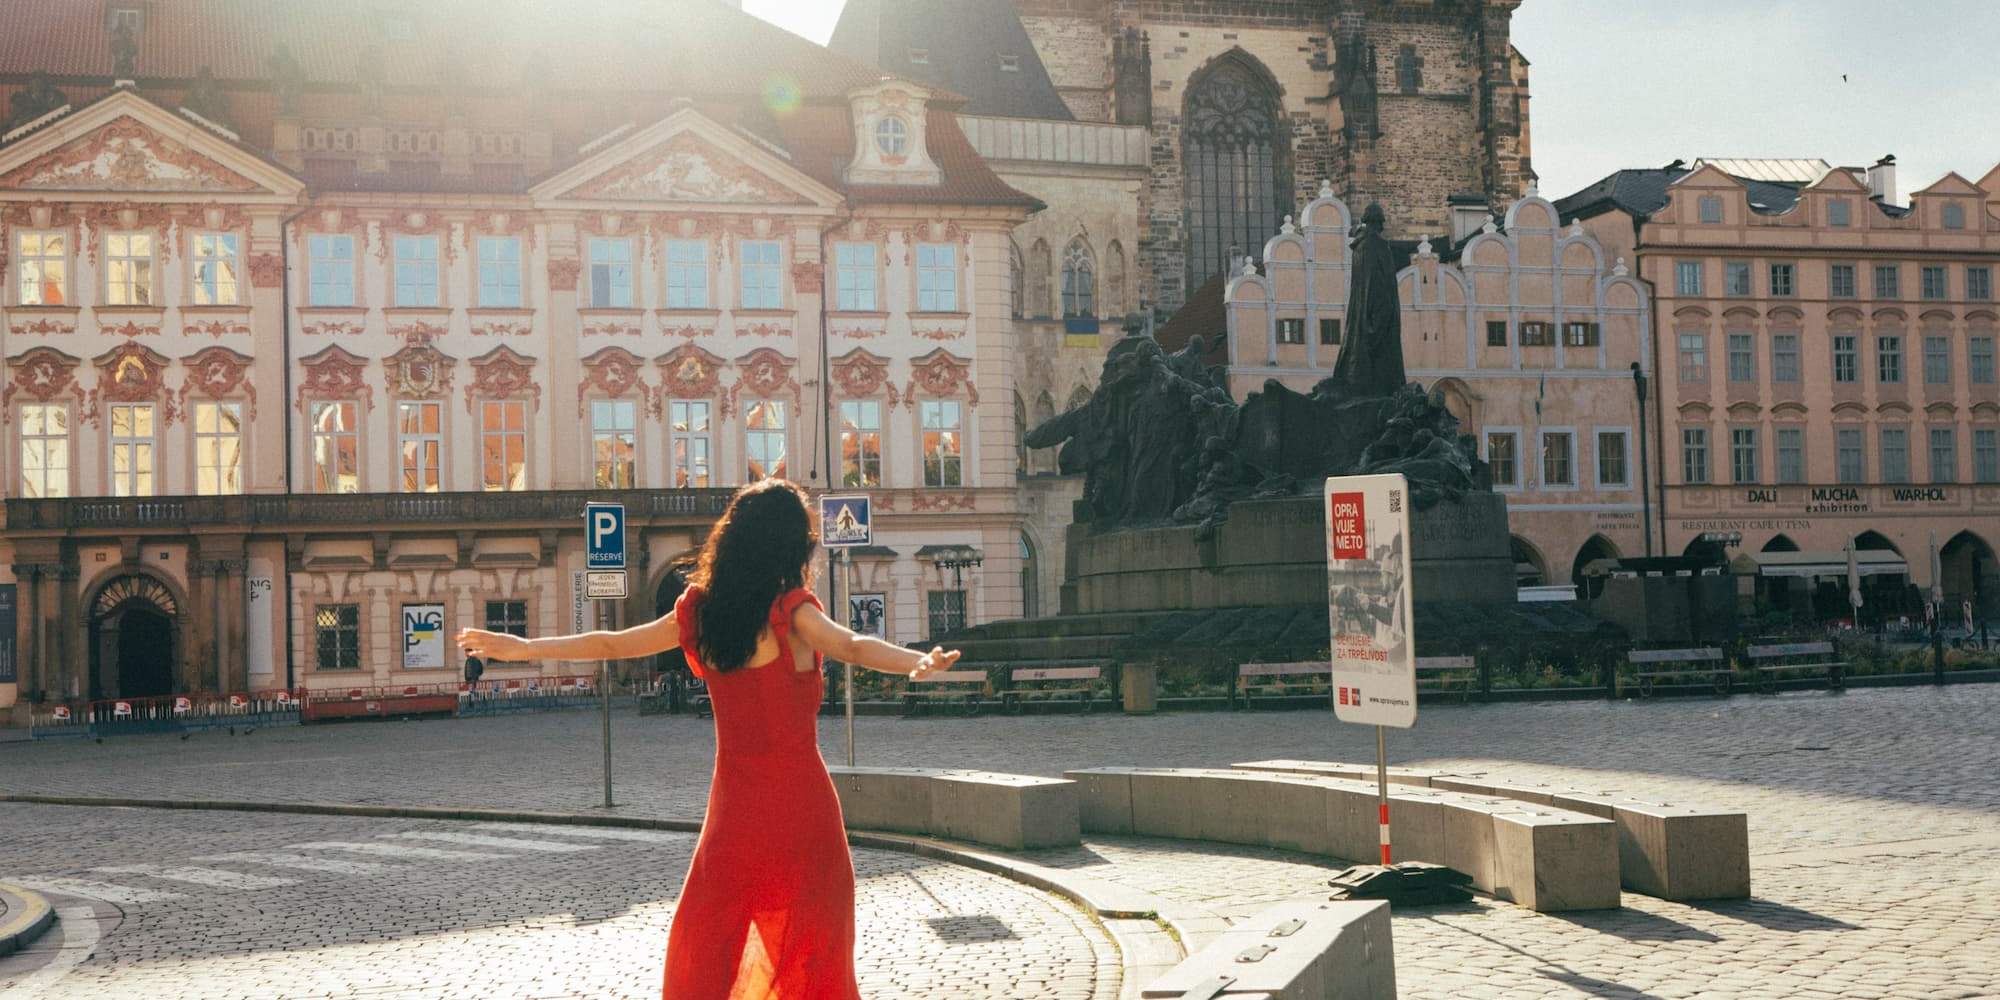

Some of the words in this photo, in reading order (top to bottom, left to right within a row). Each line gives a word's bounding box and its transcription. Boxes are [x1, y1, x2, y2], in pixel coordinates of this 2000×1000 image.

[1811, 487, 1858, 501] MUCHA
[1893, 487, 1945, 501] WARHOL
[1334, 503, 1359, 518] OPRA
[1806, 503, 1868, 513] exhibition
[595, 511, 617, 548] P
[1335, 519, 1355, 533] VUJE
[1682, 519, 1746, 530] RESTAURANT
[1336, 535, 1363, 549] ME.TO
[405, 611, 443, 631] NG
